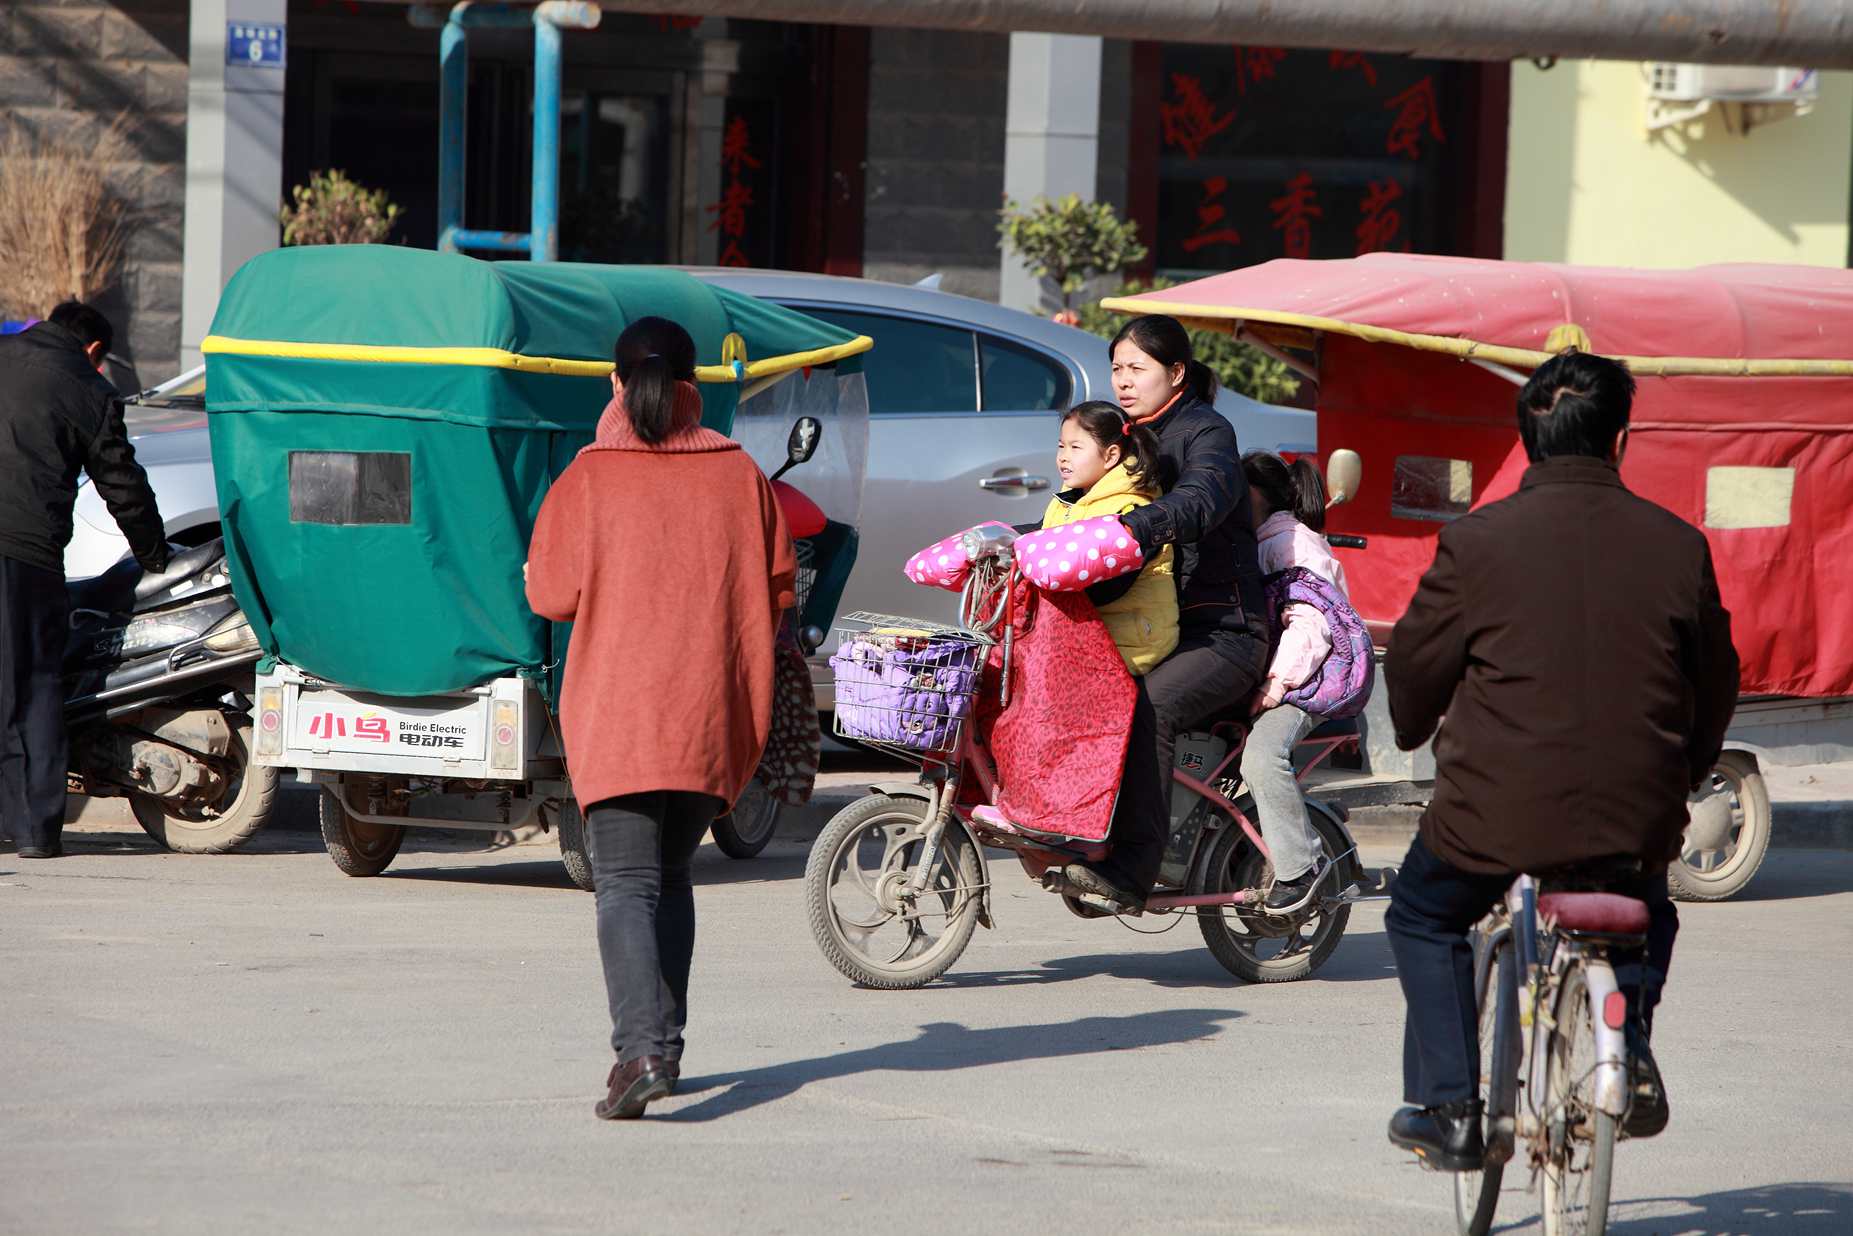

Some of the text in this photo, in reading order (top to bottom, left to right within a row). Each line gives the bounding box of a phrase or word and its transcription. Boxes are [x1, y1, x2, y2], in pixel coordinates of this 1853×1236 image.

[249, 40, 262, 62] 6
[308, 712, 391, 743] 小鸟
[399, 721, 467, 735] Birdie Electric
[399, 733, 465, 748] 电动车
